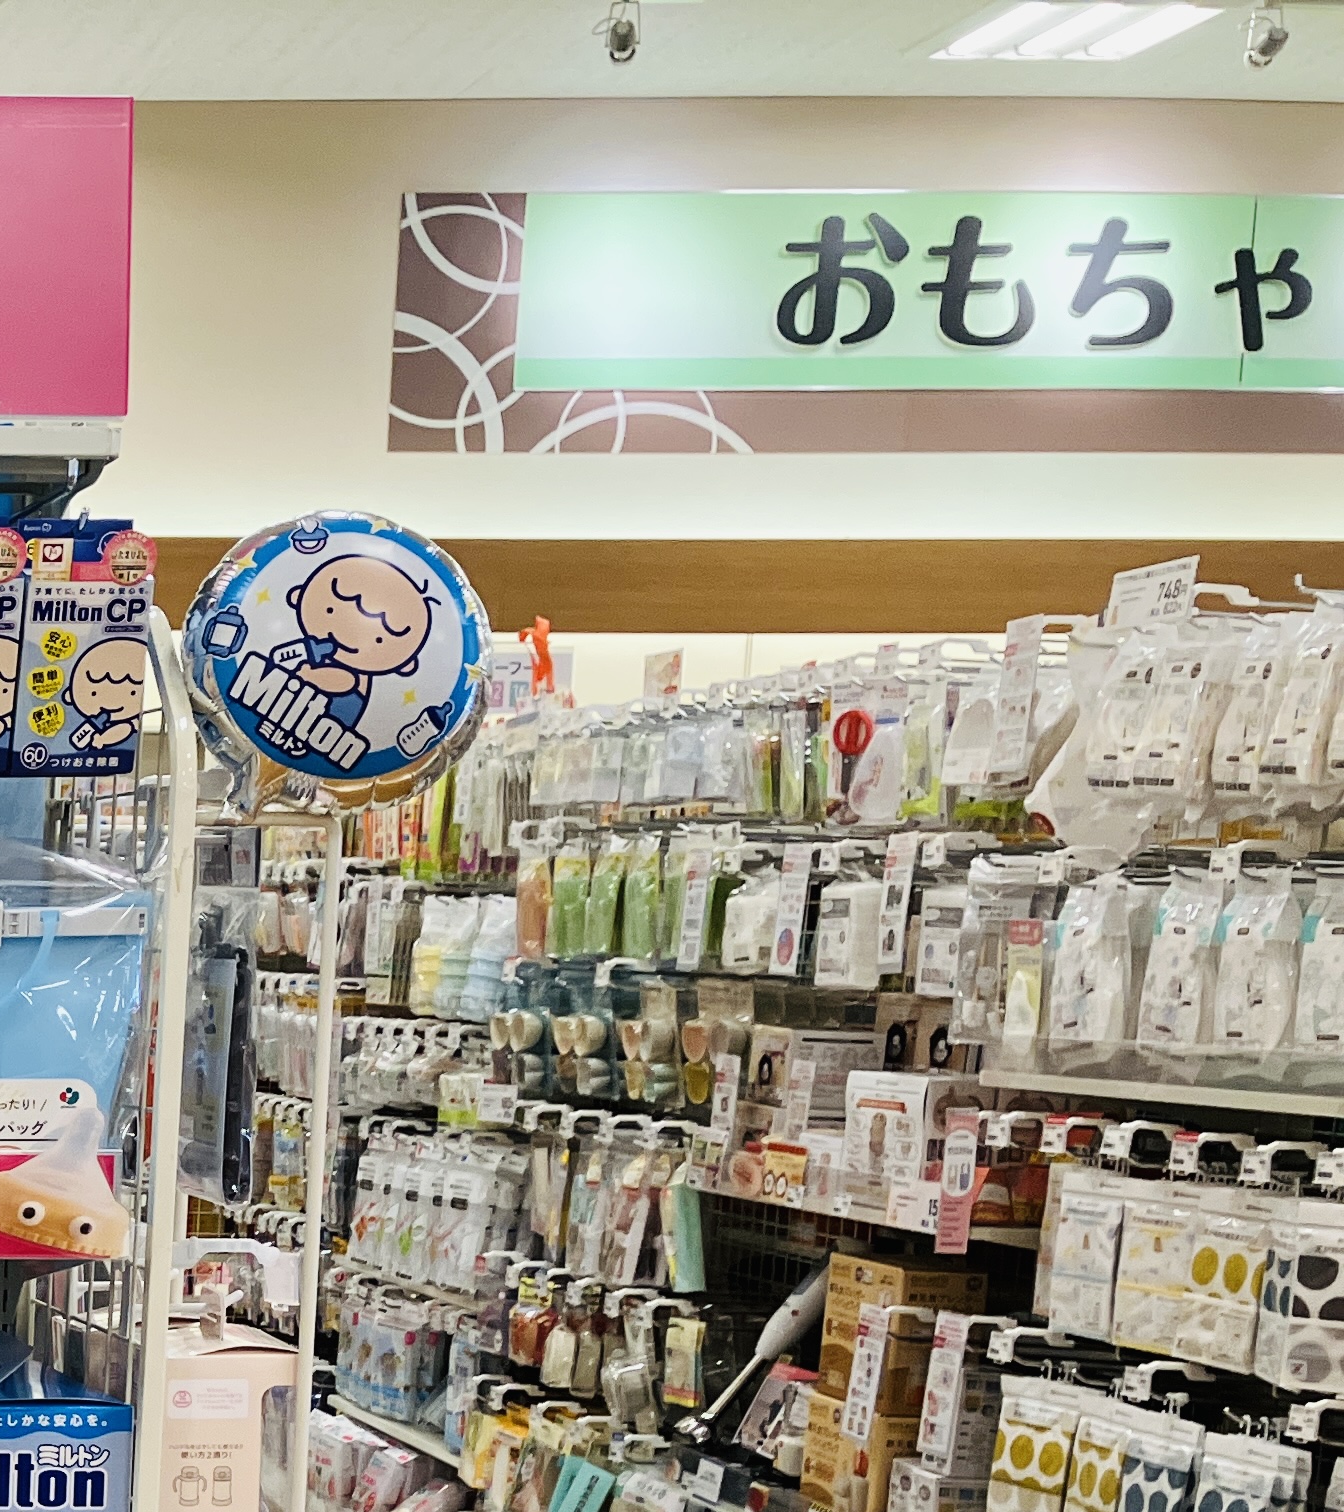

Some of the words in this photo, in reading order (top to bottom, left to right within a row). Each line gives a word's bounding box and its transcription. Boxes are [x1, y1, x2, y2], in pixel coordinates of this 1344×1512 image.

[777, 212, 1314, 351] おもちゃ
[32, 600, 102, 622] Milton
[106, 598, 146, 623] CP
[230, 652, 367, 770] Milton
[23, 747, 46, 763] 60
[37, 1443, 109, 1468] ミルトン
